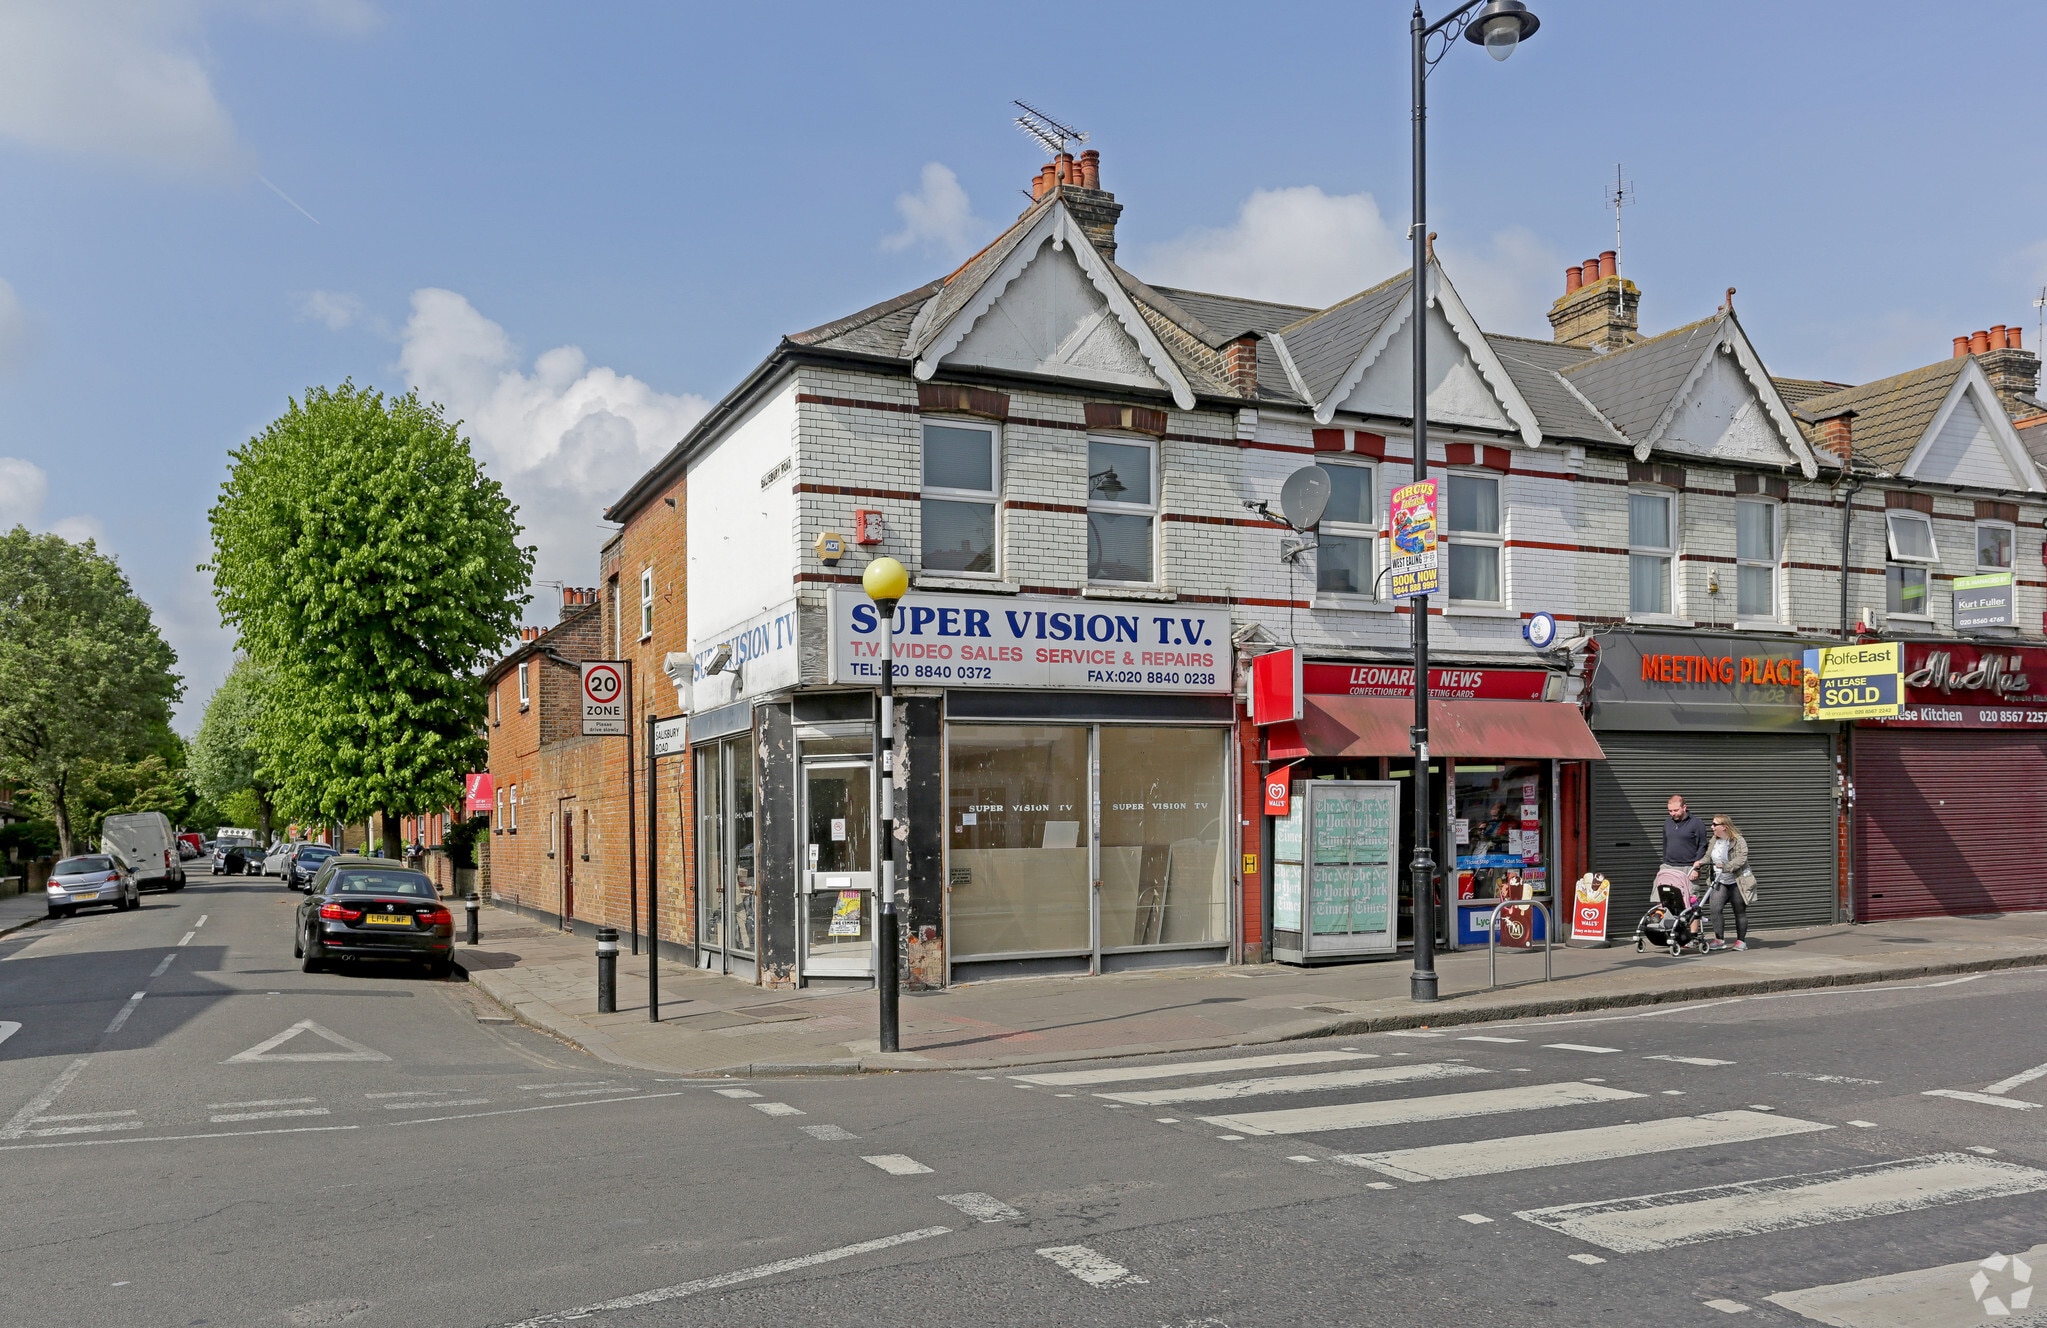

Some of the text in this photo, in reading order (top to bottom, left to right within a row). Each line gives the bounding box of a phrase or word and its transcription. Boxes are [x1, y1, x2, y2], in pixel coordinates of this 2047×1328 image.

[1393, 484, 1434, 503] CIRCUS
[826, 542, 839, 550] ADT
[1393, 557, 1405, 568] WEST
[1393, 569, 1437, 587] BOOK NOW
[1958, 598, 2006, 609] Kurt Fuller
[775, 611, 797, 650] TV
[1005, 610, 1139, 643] VISION
[1153, 617, 1212, 646] T.V.
[892, 643, 953, 660] VIDEO
[961, 645, 1023, 662] SALES
[1036, 648, 1115, 665] SERVICE
[1123, 651, 1134, 665] &
[1142, 652, 1214, 667] REPAIRS
[1825, 649, 1891, 666] RolfeEast
[915, 665, 951, 678] 8840
[957, 667, 992, 679] 0372
[1087, 670, 1142, 683] FAX:020
[1147, 672, 1179, 684] 8840
[1184, 673, 1215, 685] 0238
[1642, 654, 1803, 686] MEETING PLACE
[591, 677, 616, 692] 20
[1440, 671, 1482, 687] NEWS
[1824, 678, 1867, 688] A1 LEASE
[1349, 687, 1406, 696] CONFECTIONERY
[1451, 690, 1474, 698] CARDS
[1825, 687, 1880, 706] SOLD
[587, 706, 620, 715] ZONE
[1921, 708, 1962, 722] Kitchen
[1979, 711, 1997, 722] 020
[2000, 711, 2023, 722] 8567
[2026, 711, 2047, 723] 2257
[656, 727, 679, 741] SALISBURY
[656, 743, 668, 753] ROAD
[969, 805, 1003, 813] SUPER
[1012, 804, 1050, 812] VISION
[1194, 802, 1208, 810] TV
[1316, 799, 1335, 813] The
[1354, 799, 1373, 812] The
[1245, 856, 1255, 871] H
[1314, 869, 1333, 882] The
[1352, 868, 1371, 882] The
